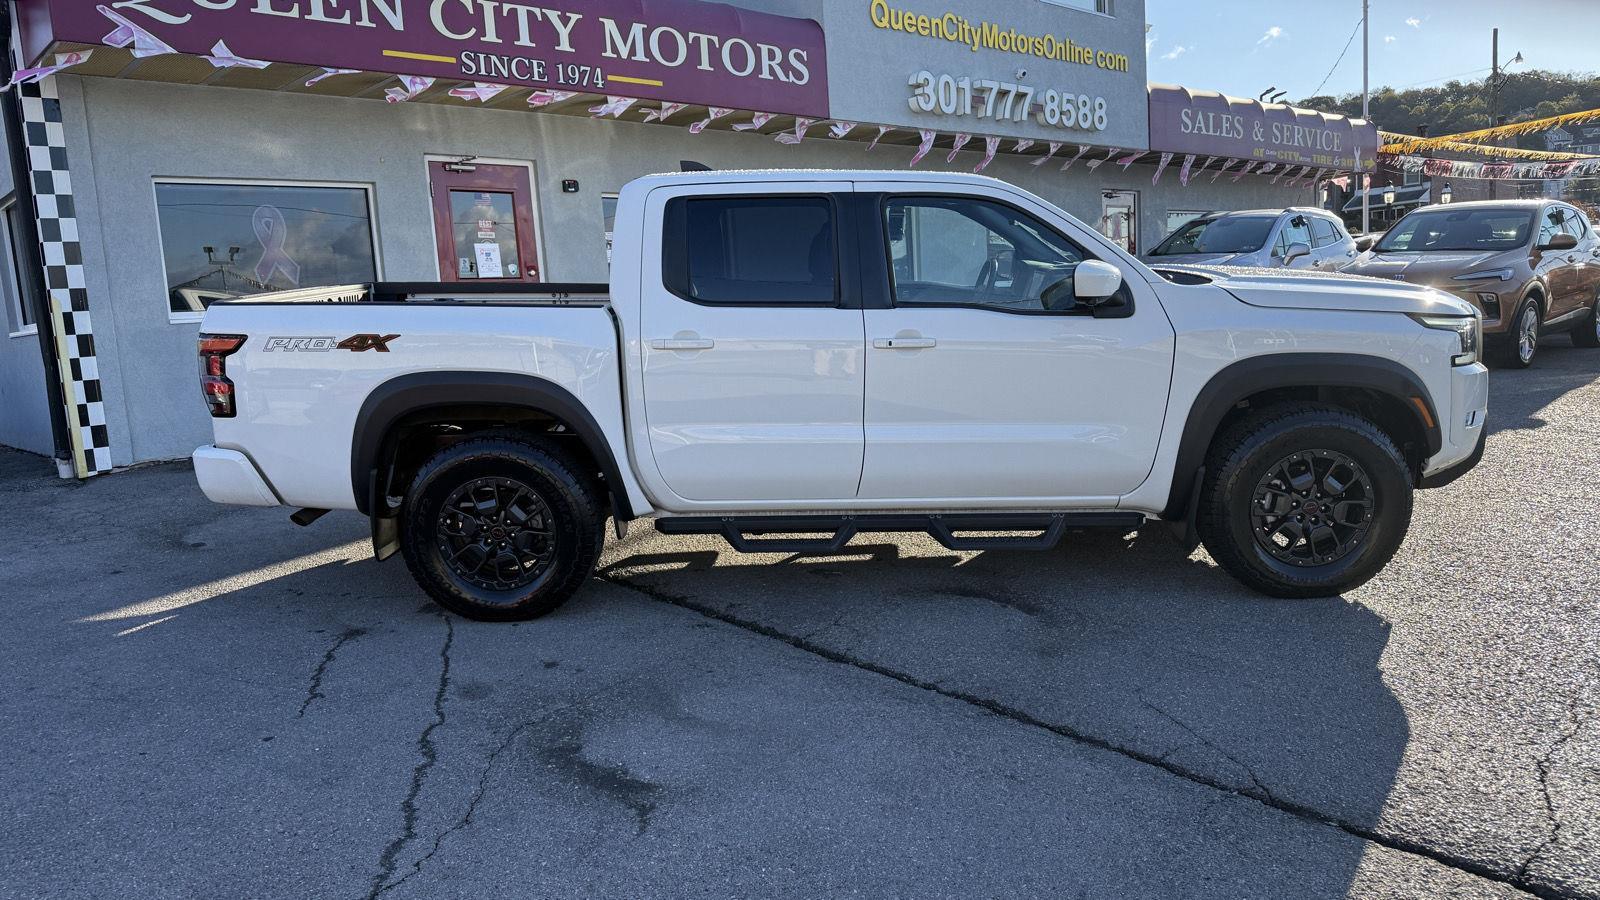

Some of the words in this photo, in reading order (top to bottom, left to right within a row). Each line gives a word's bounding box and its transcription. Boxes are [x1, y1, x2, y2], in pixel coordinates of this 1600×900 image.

[428, 0, 583, 53] CITY
[598, 17, 811, 86] MOTORS
[460, 51, 548, 82] SINCE
[556, 63, 605, 88] 1974
[1180, 108, 1244, 140] SALES
[1252, 120, 1265, 142] &
[1271, 122, 1342, 152] SERVICE
[1312, 154, 1333, 165] TIRE
